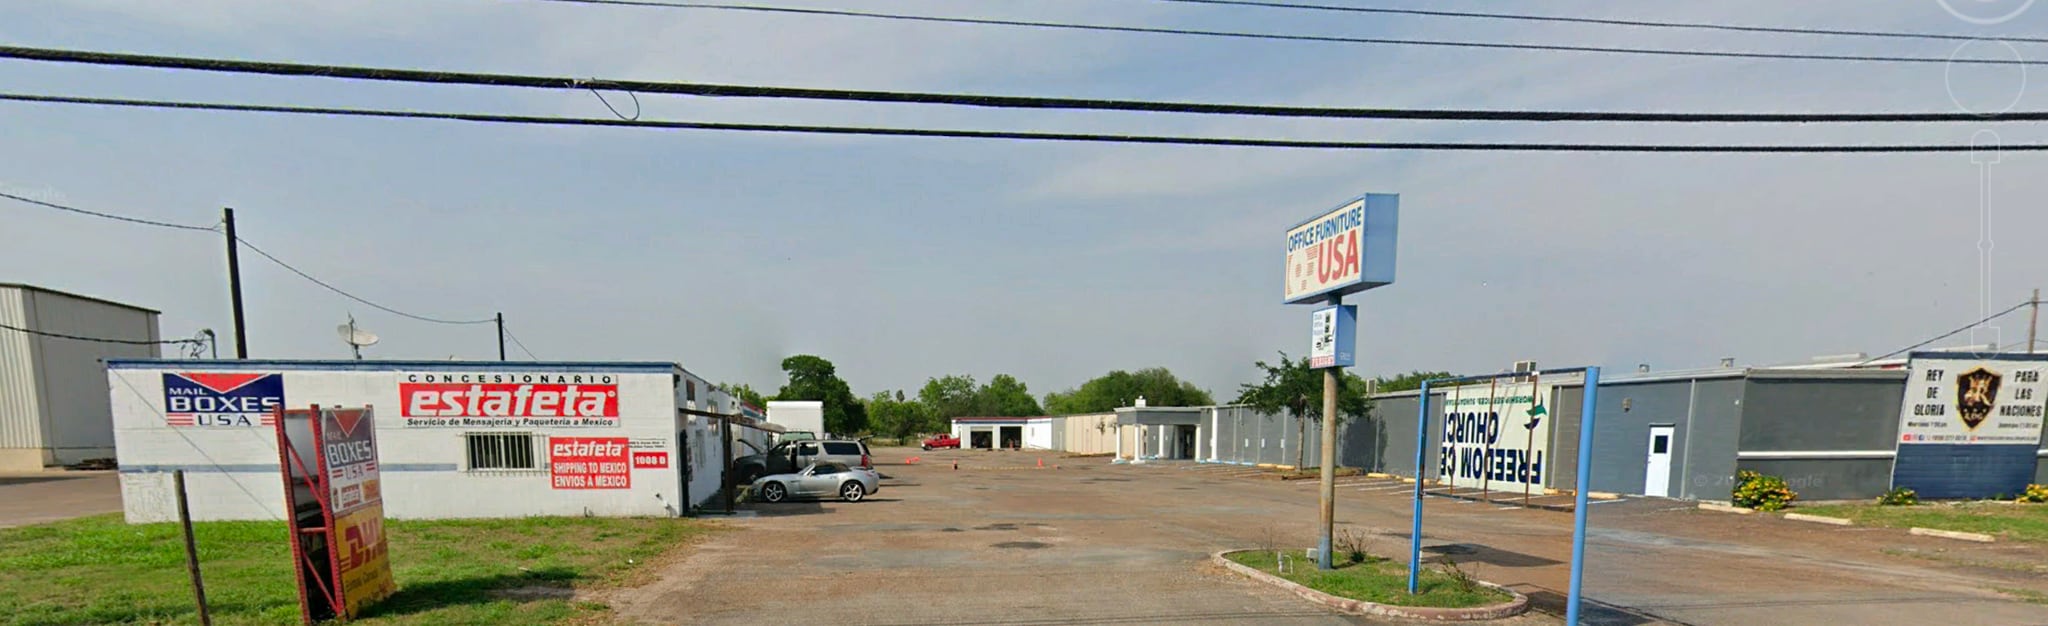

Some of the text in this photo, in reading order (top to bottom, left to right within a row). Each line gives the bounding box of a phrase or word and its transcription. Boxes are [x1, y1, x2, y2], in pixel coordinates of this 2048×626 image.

[1288, 206, 1362, 251] OFFICE FURNITURE
[1318, 229, 1359, 284] USA
[408, 374, 612, 384] CONCESIONARIO
[1926, 370, 1944, 381] REY
[2014, 370, 2040, 383] PARA
[169, 387, 207, 396] MAIL
[1927, 387, 1938, 398] DE
[2014, 388, 2033, 400] LAS
[170, 397, 280, 412] BOXES
[409, 385, 606, 416] estafeta
[1914, 404, 1945, 416] GLORIA
[2000, 405, 2042, 417] NACIONES
[197, 415, 252, 426] USA
[407, 418, 445, 426] Servicio
[448, 418, 458, 426] de
[514, 419, 520, 427] y
[329, 441, 372, 466] BOXES
[553, 442, 624, 457] estafeta
[554, 463, 627, 474] SHIPPING TO MEXICO
[1461, 447, 1542, 484] FREEDOM
[345, 467, 364, 480] USA
[555, 475, 627, 487] ENVIOS A MEXICO
